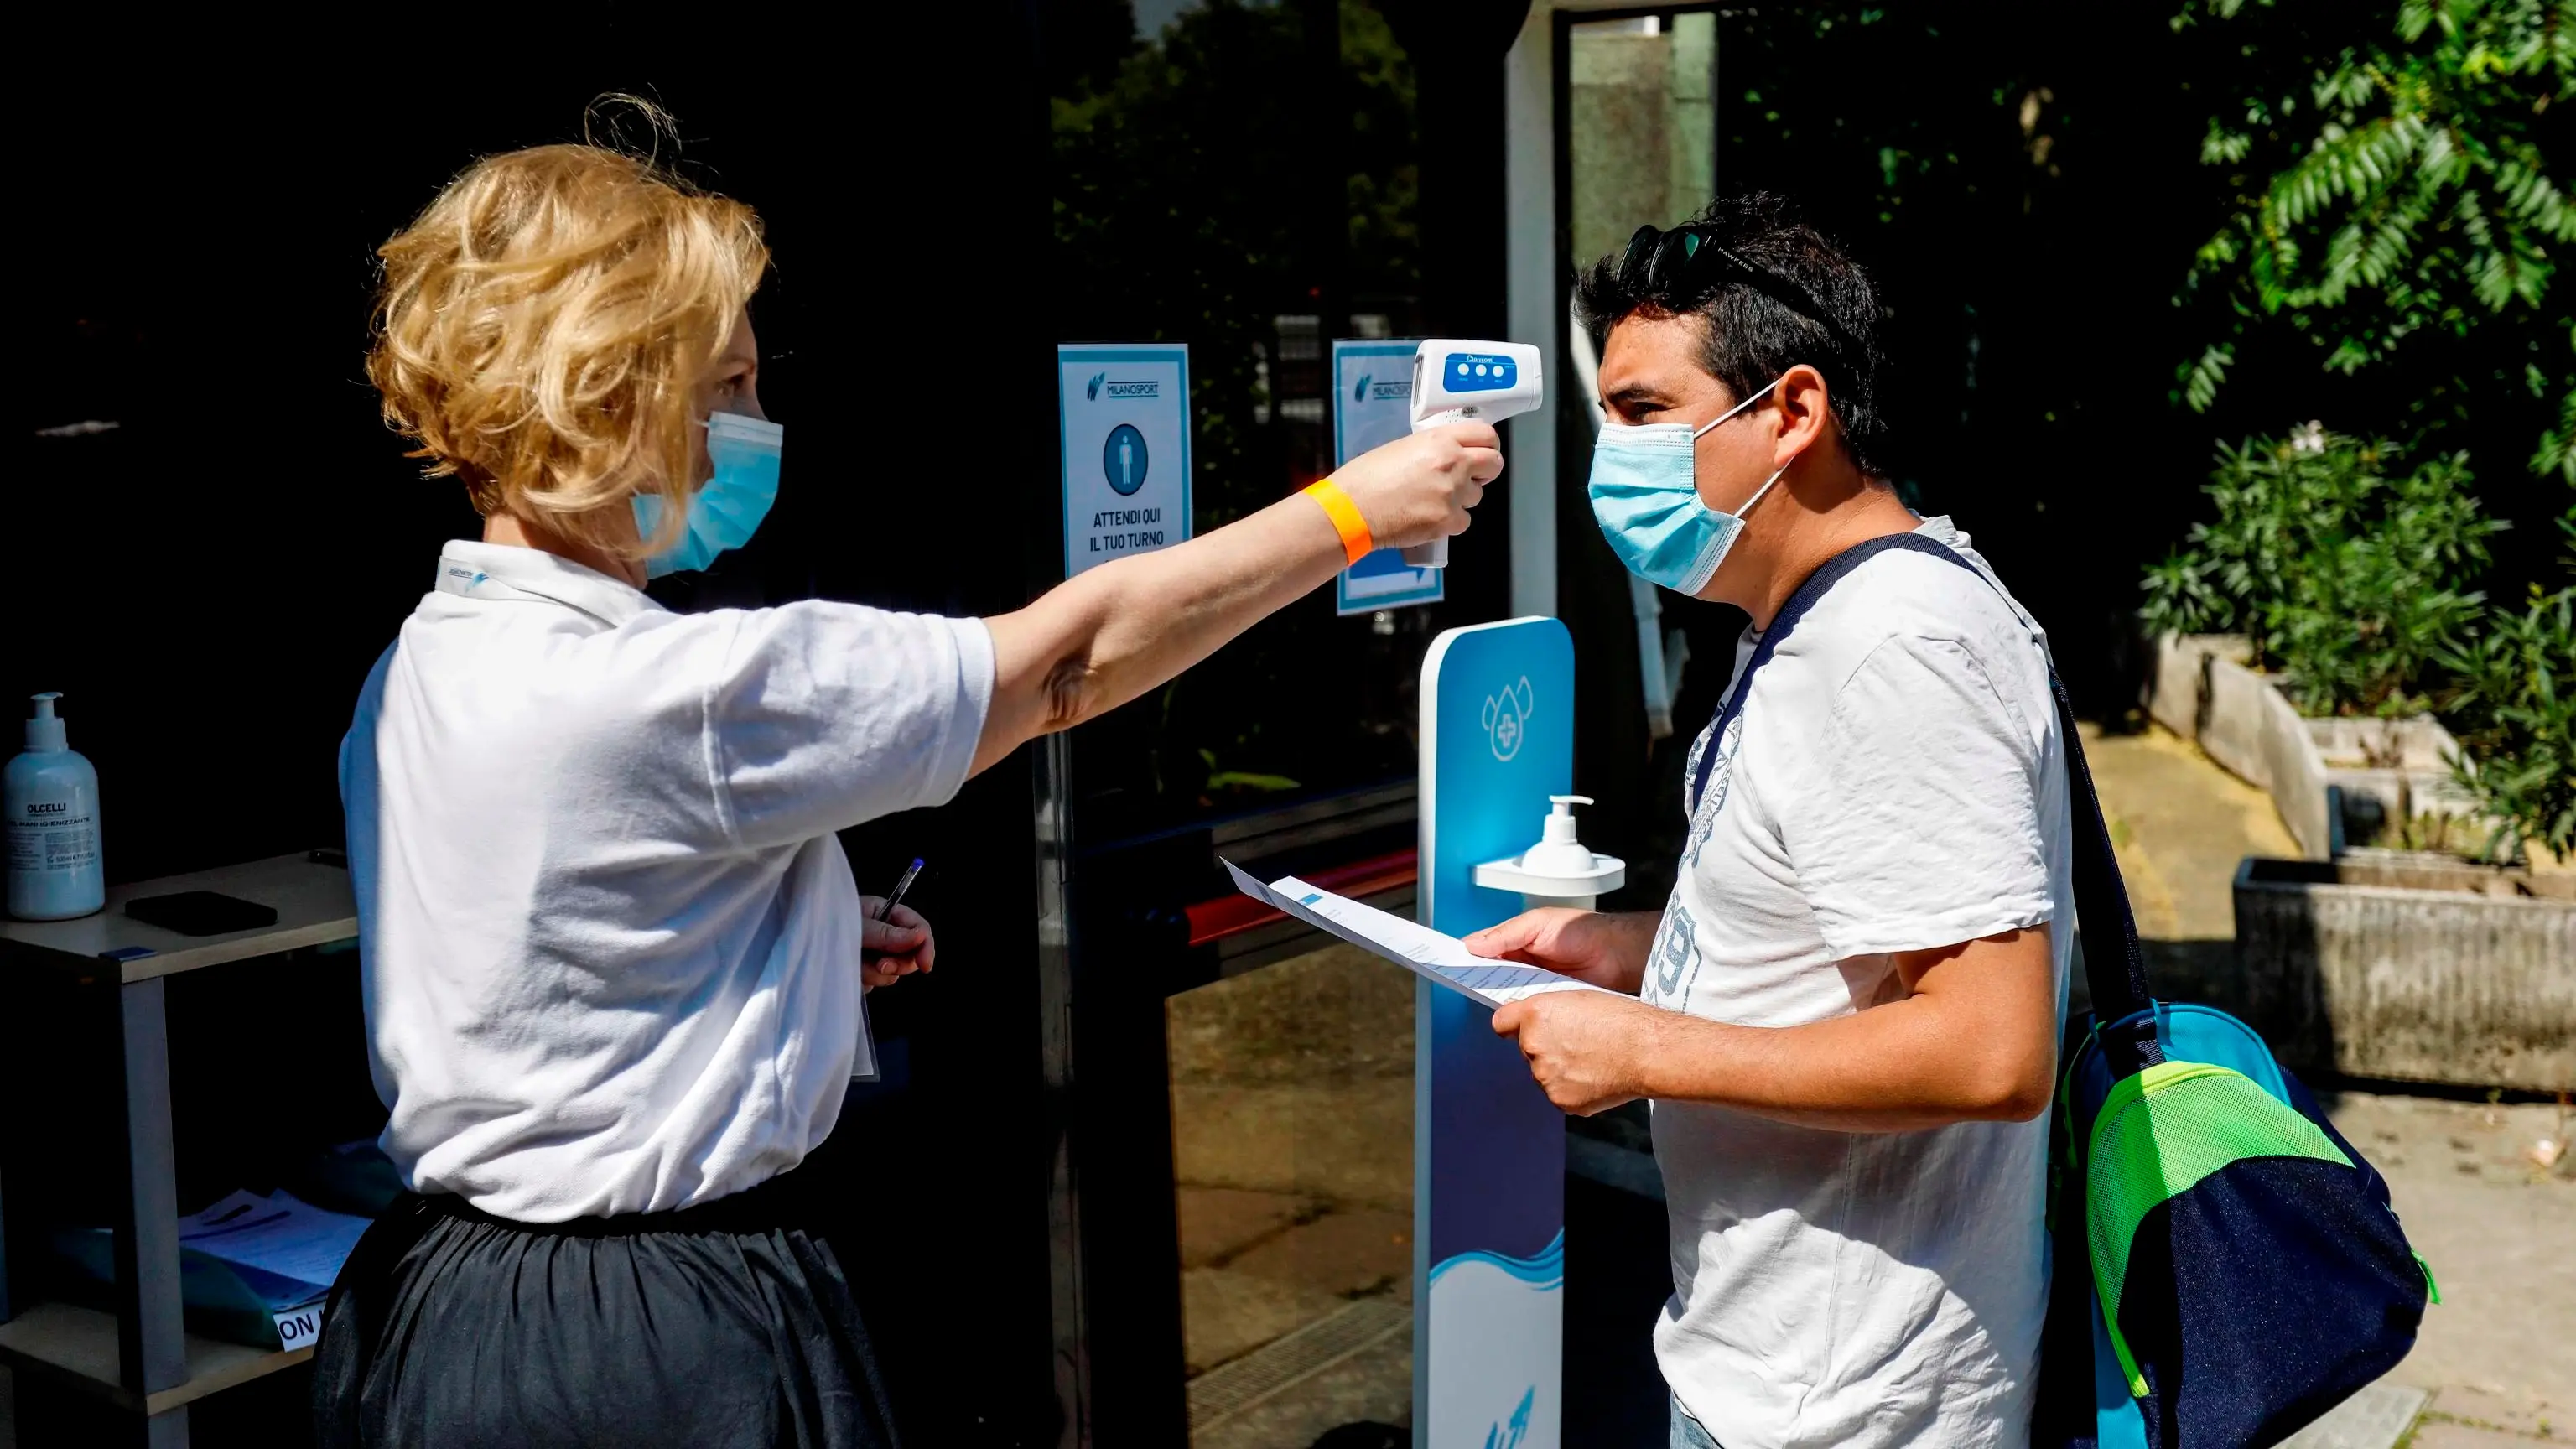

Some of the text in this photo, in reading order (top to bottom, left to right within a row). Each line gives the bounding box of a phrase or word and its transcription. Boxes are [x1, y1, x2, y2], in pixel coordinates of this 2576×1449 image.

[1717, 246, 1754, 273] HAWKERS
[1107, 384, 1159, 395] MILANOSPORT
[1093, 507, 1161, 527] ATTENDI QUI
[1090, 530, 1164, 552] IL TUO TURNO
[27, 802, 66, 813] OLCELLI
[39, 816, 91, 828] IGIENIZZANTE
[278, 1313, 314, 1341] ON
